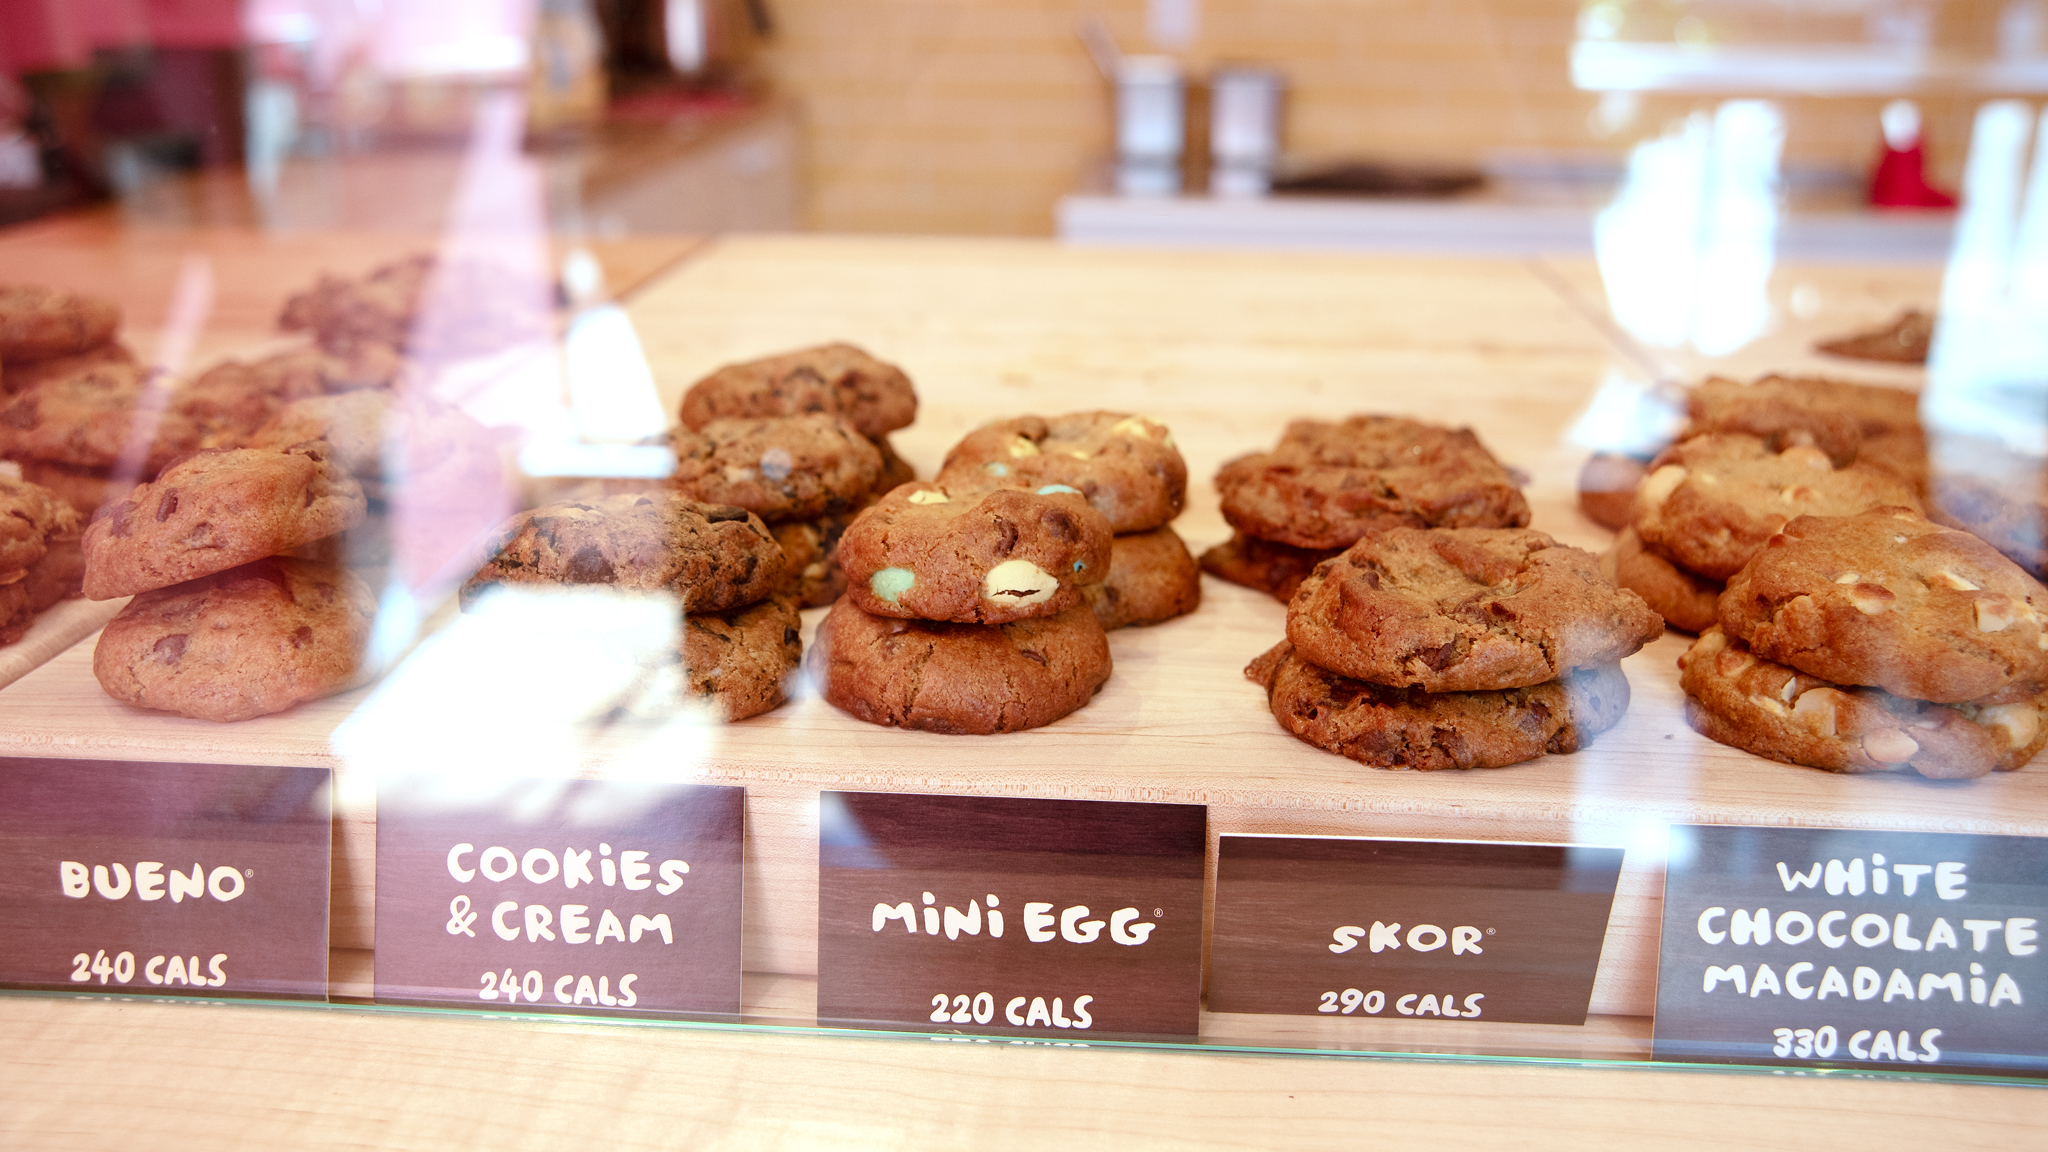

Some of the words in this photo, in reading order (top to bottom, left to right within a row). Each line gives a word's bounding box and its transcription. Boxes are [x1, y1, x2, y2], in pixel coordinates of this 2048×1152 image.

[445, 894, 478, 938] &
[491, 900, 673, 945] CREAM
[1697, 906, 2038, 956] CHOCOLATE
[70, 949, 136, 985] 240
[144, 953, 228, 987] CALS
[478, 967, 544, 1004] 240
[553, 973, 638, 1008] CALS
[1317, 988, 1387, 1016] 290
[1394, 992, 1486, 1018] CALS
[929, 991, 995, 1025] 220
[1005, 994, 1094, 1029] CALS
[1772, 1025, 1838, 1059] 330
[1848, 1028, 1943, 1063] CALS
